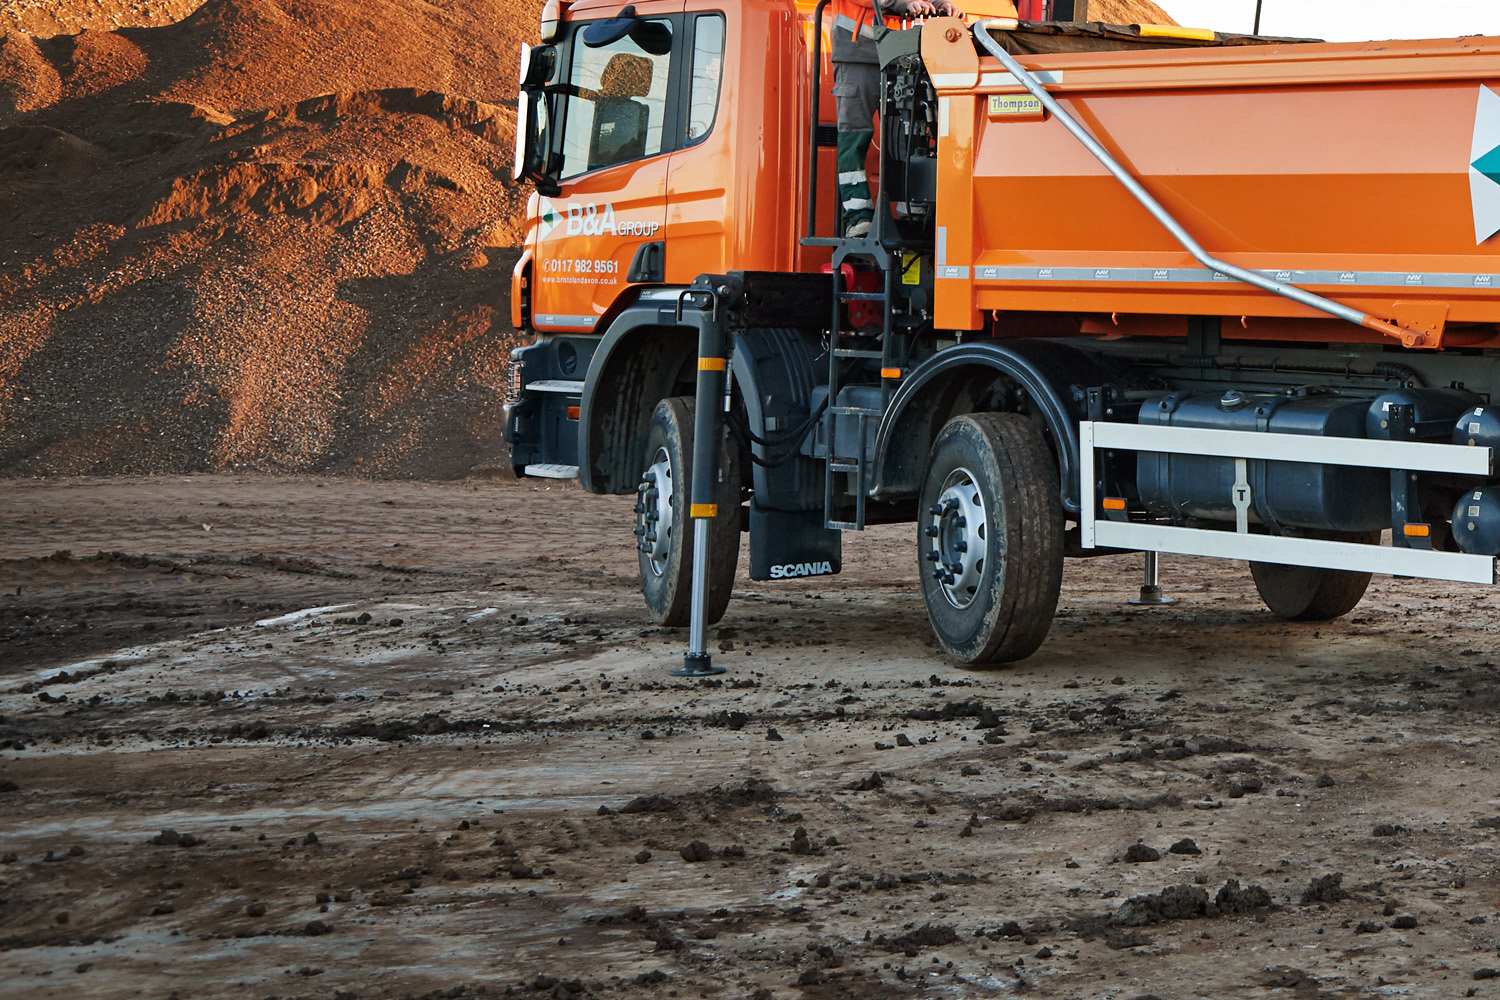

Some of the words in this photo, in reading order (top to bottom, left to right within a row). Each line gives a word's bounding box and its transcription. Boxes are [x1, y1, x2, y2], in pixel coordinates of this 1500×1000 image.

[992, 96, 1039, 113] Thompson
[566, 202, 617, 236] B&A
[618, 221, 659, 237] GROUP
[551, 260, 572, 273] 0117
[575, 260, 592, 273] 982
[594, 260, 618, 274] 9561
[542, 276, 617, 285] www.bristolandavon.co.uk
[1237, 489, 1246, 501] T
[769, 561, 833, 579] SCANIA
